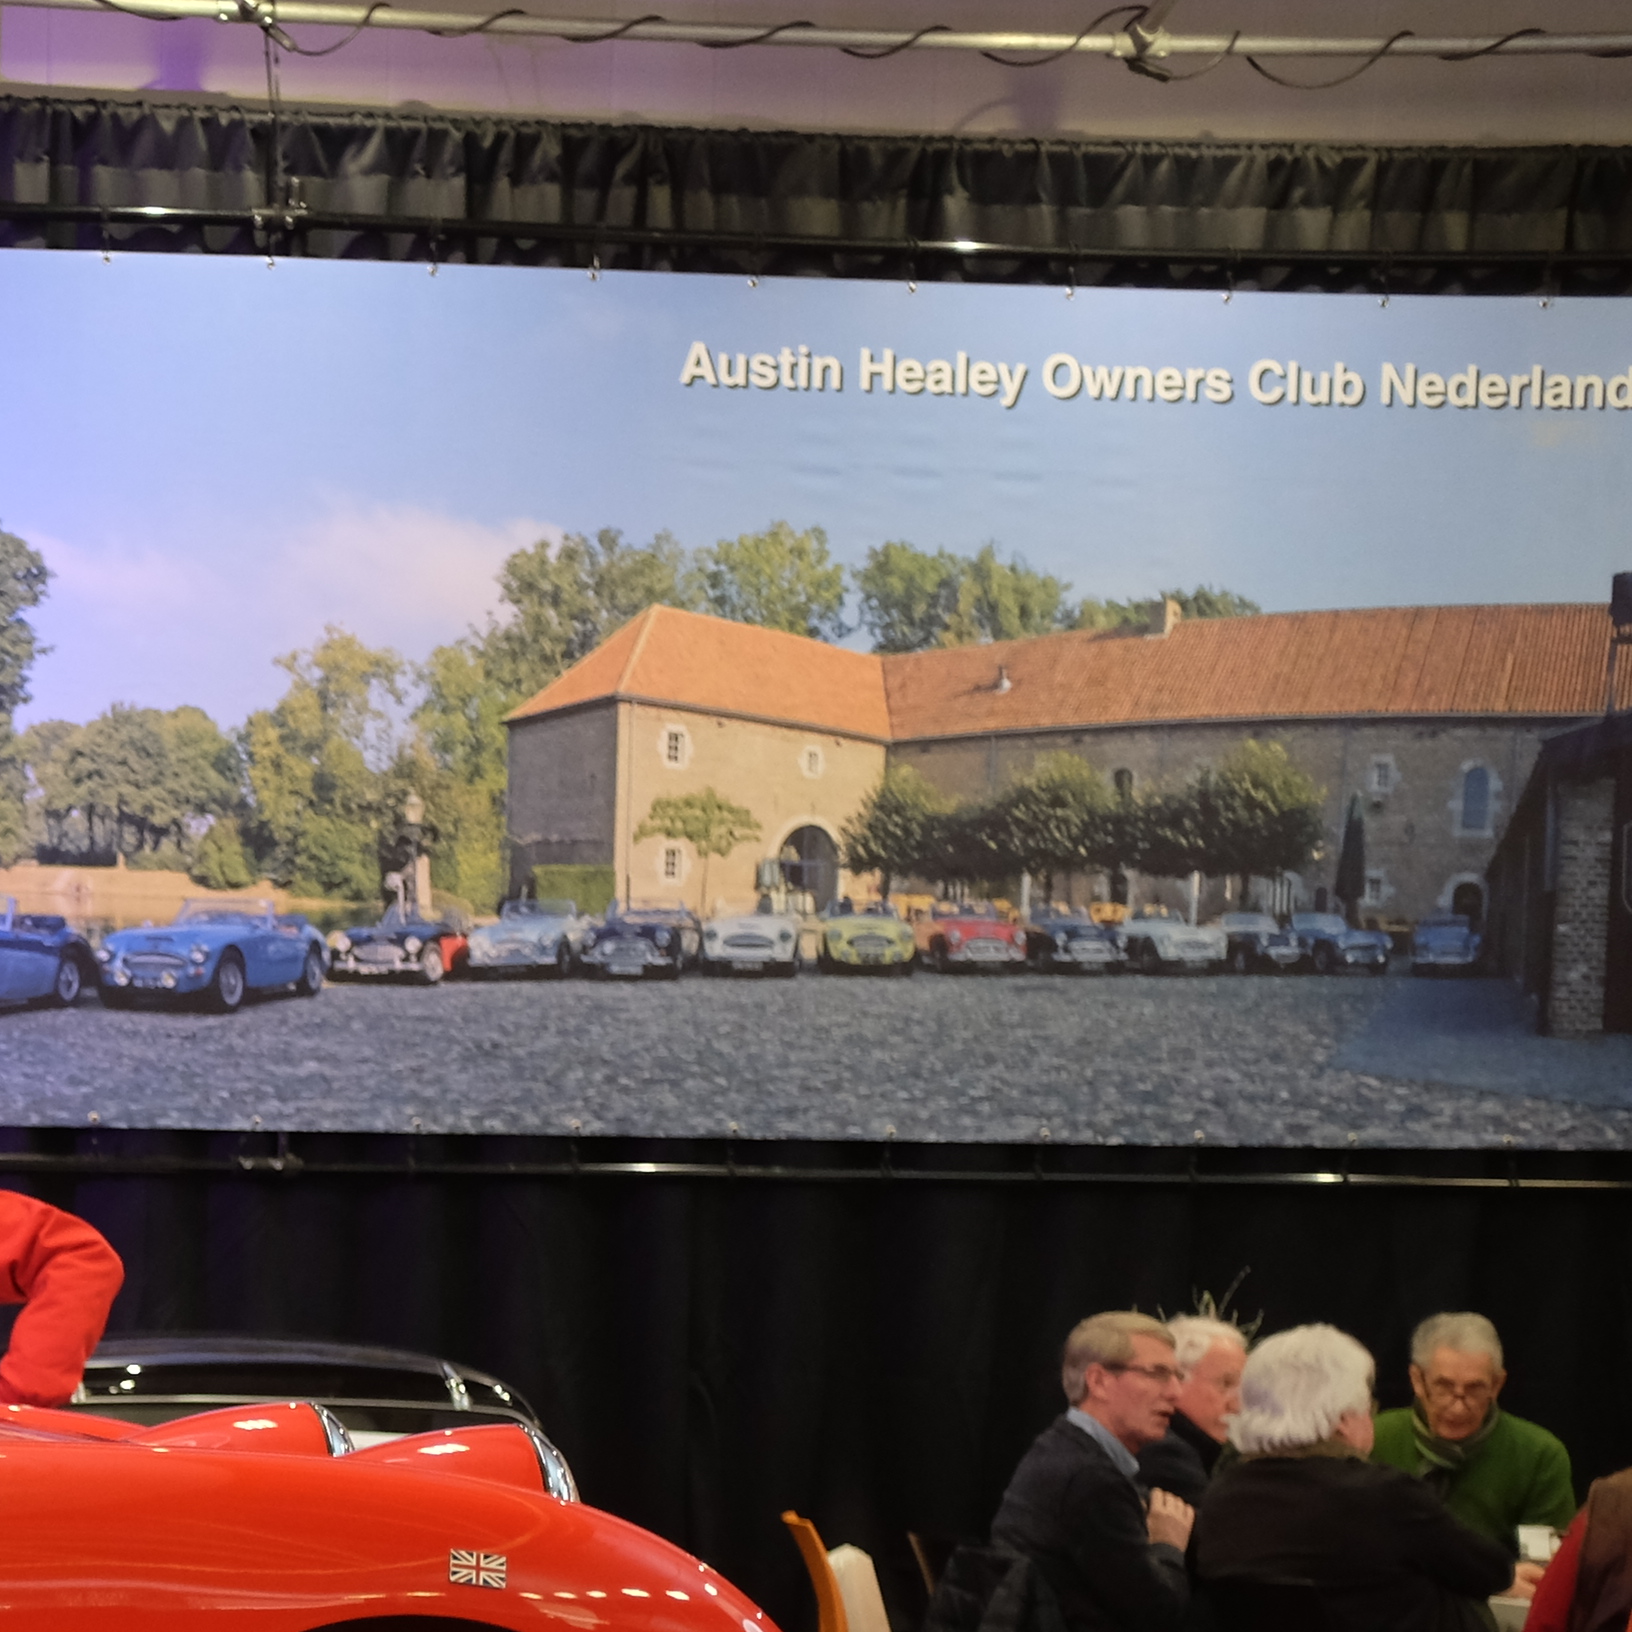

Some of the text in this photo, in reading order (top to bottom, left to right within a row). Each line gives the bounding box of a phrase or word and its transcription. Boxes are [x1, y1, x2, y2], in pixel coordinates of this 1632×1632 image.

[679, 339, 1632, 412] Austin Healey Owners Club Nederland
